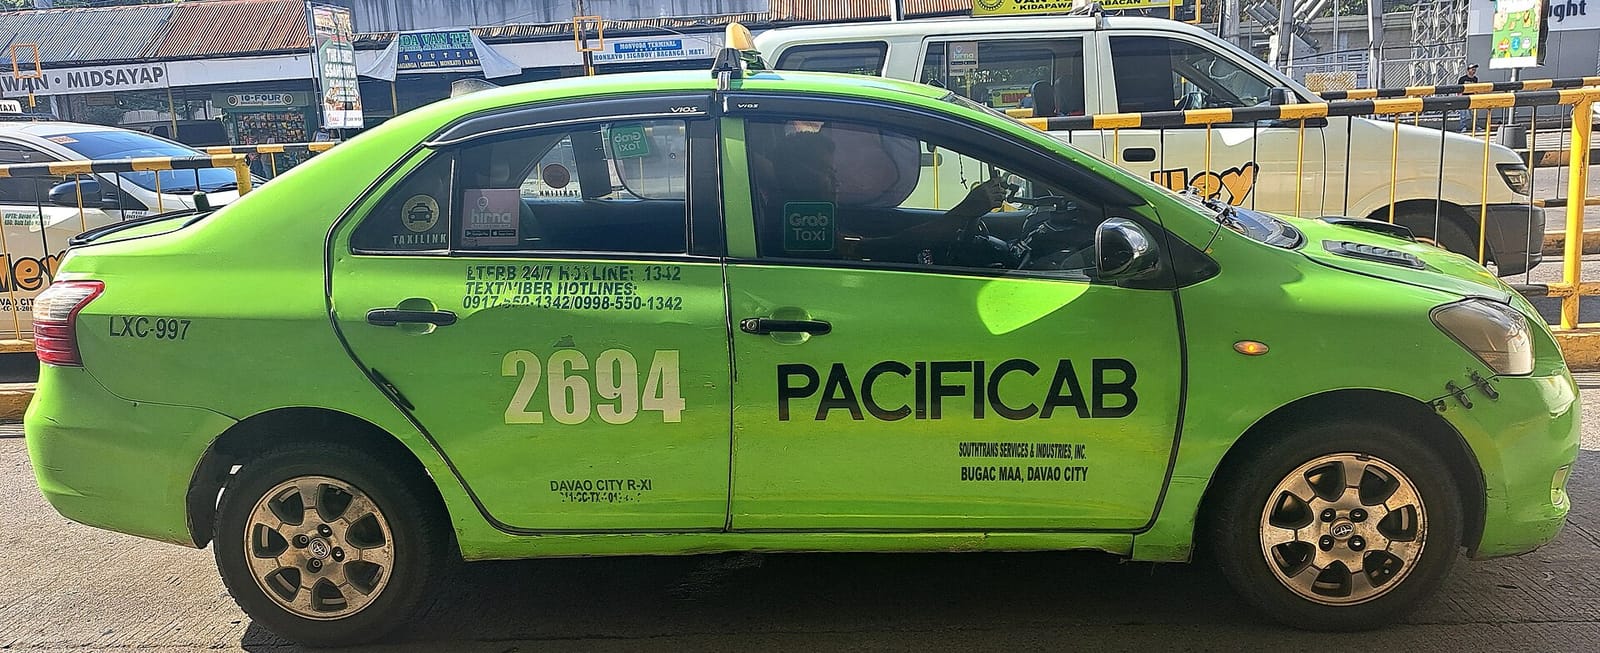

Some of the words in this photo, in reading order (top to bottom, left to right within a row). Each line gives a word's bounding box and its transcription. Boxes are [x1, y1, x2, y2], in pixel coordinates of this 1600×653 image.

[1019, 2, 1073, 10] KIDAPAWA
[1549, 0, 1587, 22] ght
[1, 74, 49, 92] WAN
[67, 66, 164, 89] MIDSAYAP
[0, 104, 17, 112] TAXI
[471, 209, 512, 224] hirna
[790, 212, 829, 227] Grab
[392, 234, 447, 245] TAXILINK
[792, 227, 826, 241] Taxi
[521, 264, 554, 280] 24/7
[643, 265, 681, 281] 1342
[466, 281, 553, 295] TEXT/VIBER
[557, 282, 638, 296] HOTLINES:
[20, 298, 35, 306] CIT
[109, 316, 192, 340] LXC-997
[501, 349, 686, 425] 2694
[776, 358, 1139, 422] PACIFICAB
[959, 442, 999, 457] SOUTHTRANS
[1000, 442, 1029, 458] SERVICES
[1030, 444, 1035, 457] &
[1036, 443, 1073, 460] INDUSTRIES,
[1074, 444, 1087, 459] INC.
[961, 466, 996, 481] BUGAC
[999, 466, 1024, 483] MAA,
[1027, 466, 1061, 481] DAVAO
[1064, 466, 1089, 481] CITY
[550, 480, 593, 491] DAVAO
[596, 479, 624, 491] CITY
[627, 479, 652, 491] R-XI
